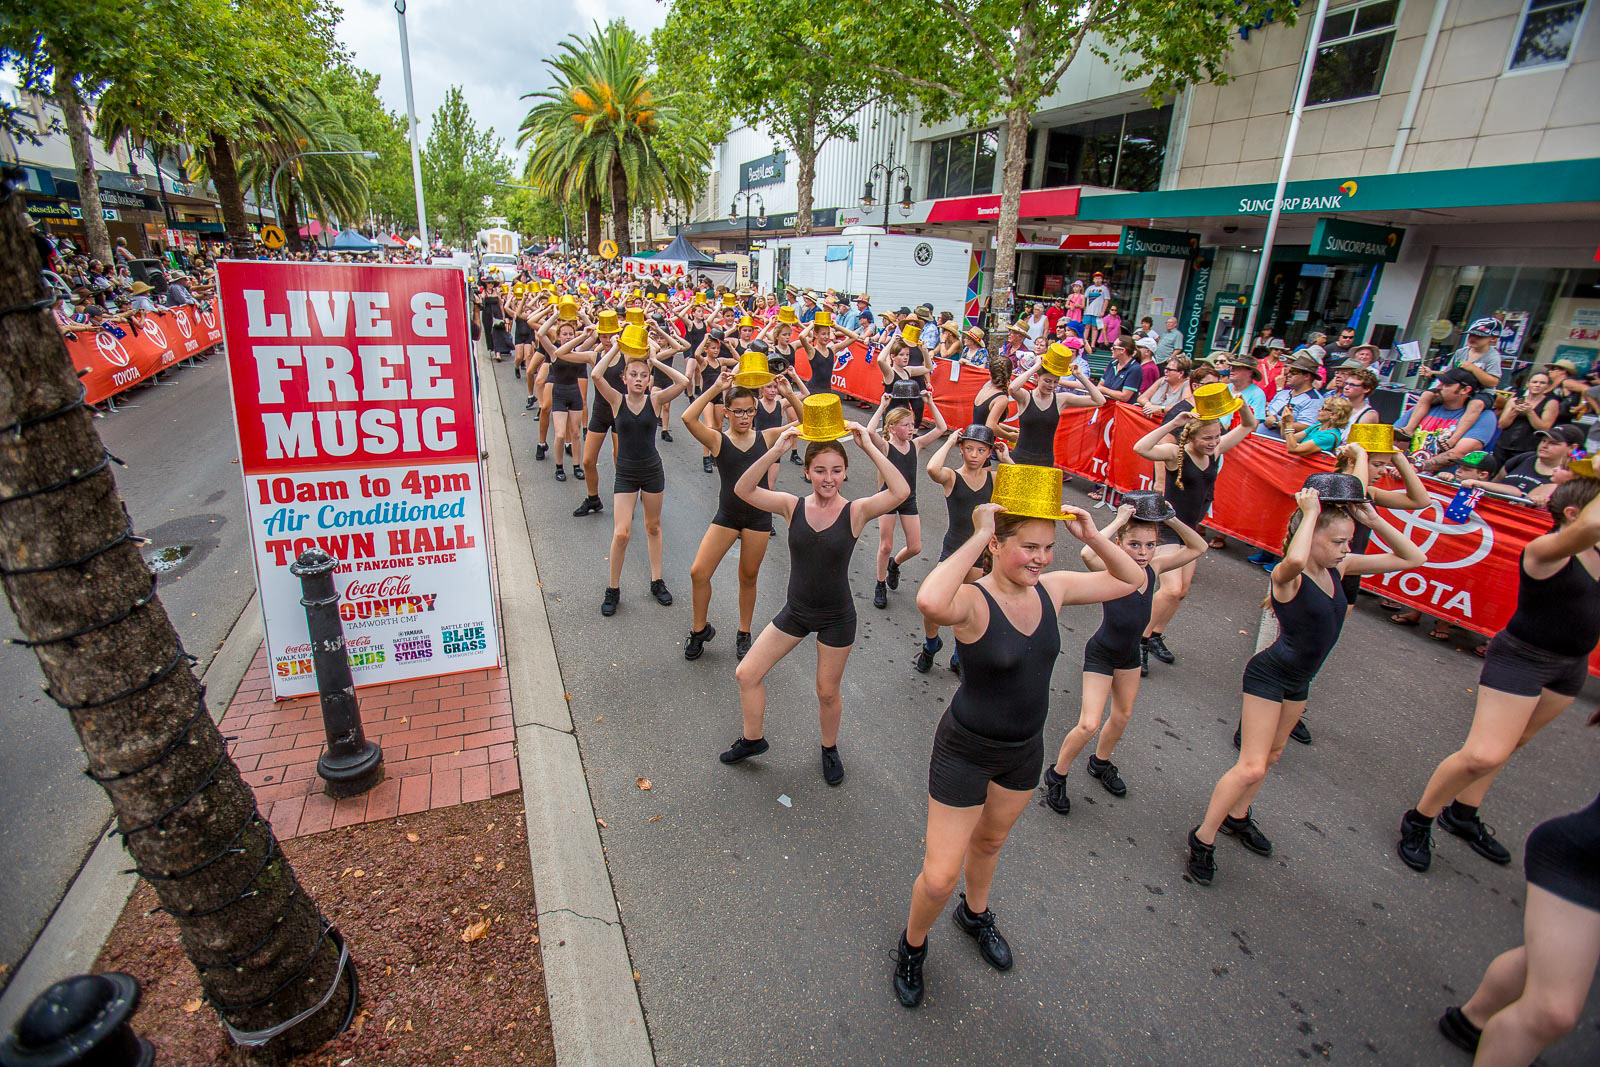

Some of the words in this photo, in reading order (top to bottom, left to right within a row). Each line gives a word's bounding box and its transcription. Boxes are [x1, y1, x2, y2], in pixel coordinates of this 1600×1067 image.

[1238, 198, 1300, 212] SUNCRP
[1301, 196, 1342, 209] BANK
[489, 233, 513, 255] 50
[1125, 230, 1134, 250] ATM
[1135, 240, 1171, 254] SUNCORP
[1171, 246, 1191, 256] BANK
[1326, 236, 1366, 254] SUNCORP
[1366, 246, 1387, 256] BANK
[625, 261, 684, 275] HENNA
[1196, 267, 1210, 301] BANK
[243, 289, 393, 338] LIVE
[410, 292, 448, 338] &
[184, 339, 199, 352] TOYOTA
[112, 366, 140, 386] TOYOTA
[252, 344, 455, 404] FREE
[831, 374, 846, 388] OTA
[261, 406, 458, 460] MUSIC
[257, 477, 350, 505] 10am
[360, 474, 391, 498] to
[401, 470, 472, 500] 4pm
[263, 507, 310, 537] Air
[317, 497, 466, 529] Conditioned
[387, 524, 476, 556] HALL
[333, 563, 352, 575] OM
[356, 557, 414, 572] FANZONE
[417, 553, 457, 566] STAGE
[345, 574, 413, 601] Coca-Cola
[1361, 570, 1472, 618] YOTA
[340, 593, 438, 622] OUNTRY
[347, 618, 399, 630] TAMWORTH
[400, 615, 418, 625] CMF
[345, 636, 371, 647] ca-Cola
[442, 627, 485, 644] BLUE
[394, 640, 432, 652] YOUNG
[395, 649, 433, 662] STARS
[443, 639, 487, 655] GRASS
[275, 654, 297, 662] WALK
[276, 658, 316, 677] SIN
[347, 651, 386, 667] ANDS
